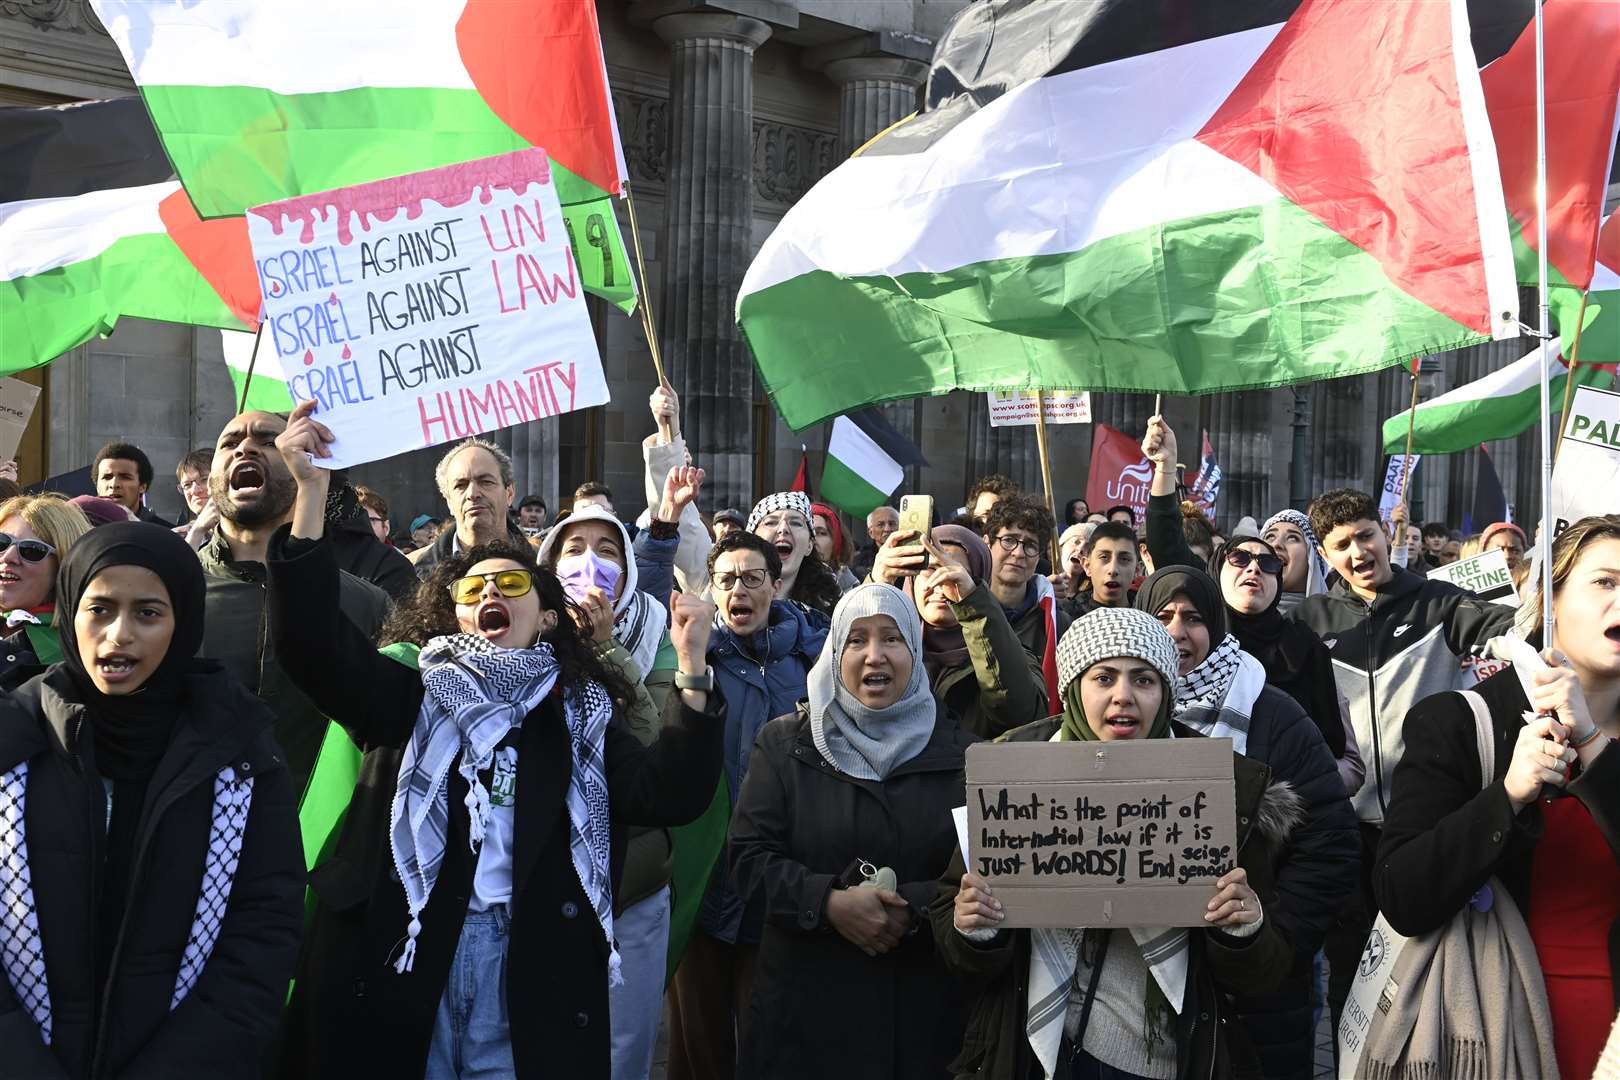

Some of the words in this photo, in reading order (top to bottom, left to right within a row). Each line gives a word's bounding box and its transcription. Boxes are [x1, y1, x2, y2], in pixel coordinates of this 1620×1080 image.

[257, 245, 353, 300] ISRAEL
[361, 218, 463, 279] AGAINST
[480, 199, 547, 251] UN
[270, 296, 361, 357] ISRAEL
[367, 267, 471, 335] AGAINST
[492, 247, 576, 314] LAW
[378, 324, 484, 395] AGAINST
[417, 361, 576, 445] HUMANITY
[1449, 560, 1481, 581] FREE
[978, 788, 1044, 821] What
[1050, 799, 1068, 820] is
[1074, 796, 1107, 821] the
[1116, 794, 1173, 827] point
[1179, 791, 1206, 820] of
[1097, 826, 1132, 846] law
[1140, 823, 1157, 846] if
[1165, 822, 1183, 845] it
[1194, 823, 1213, 841] is
[1032, 848, 1127, 884] WORDS!
[1139, 851, 1175, 878] End
